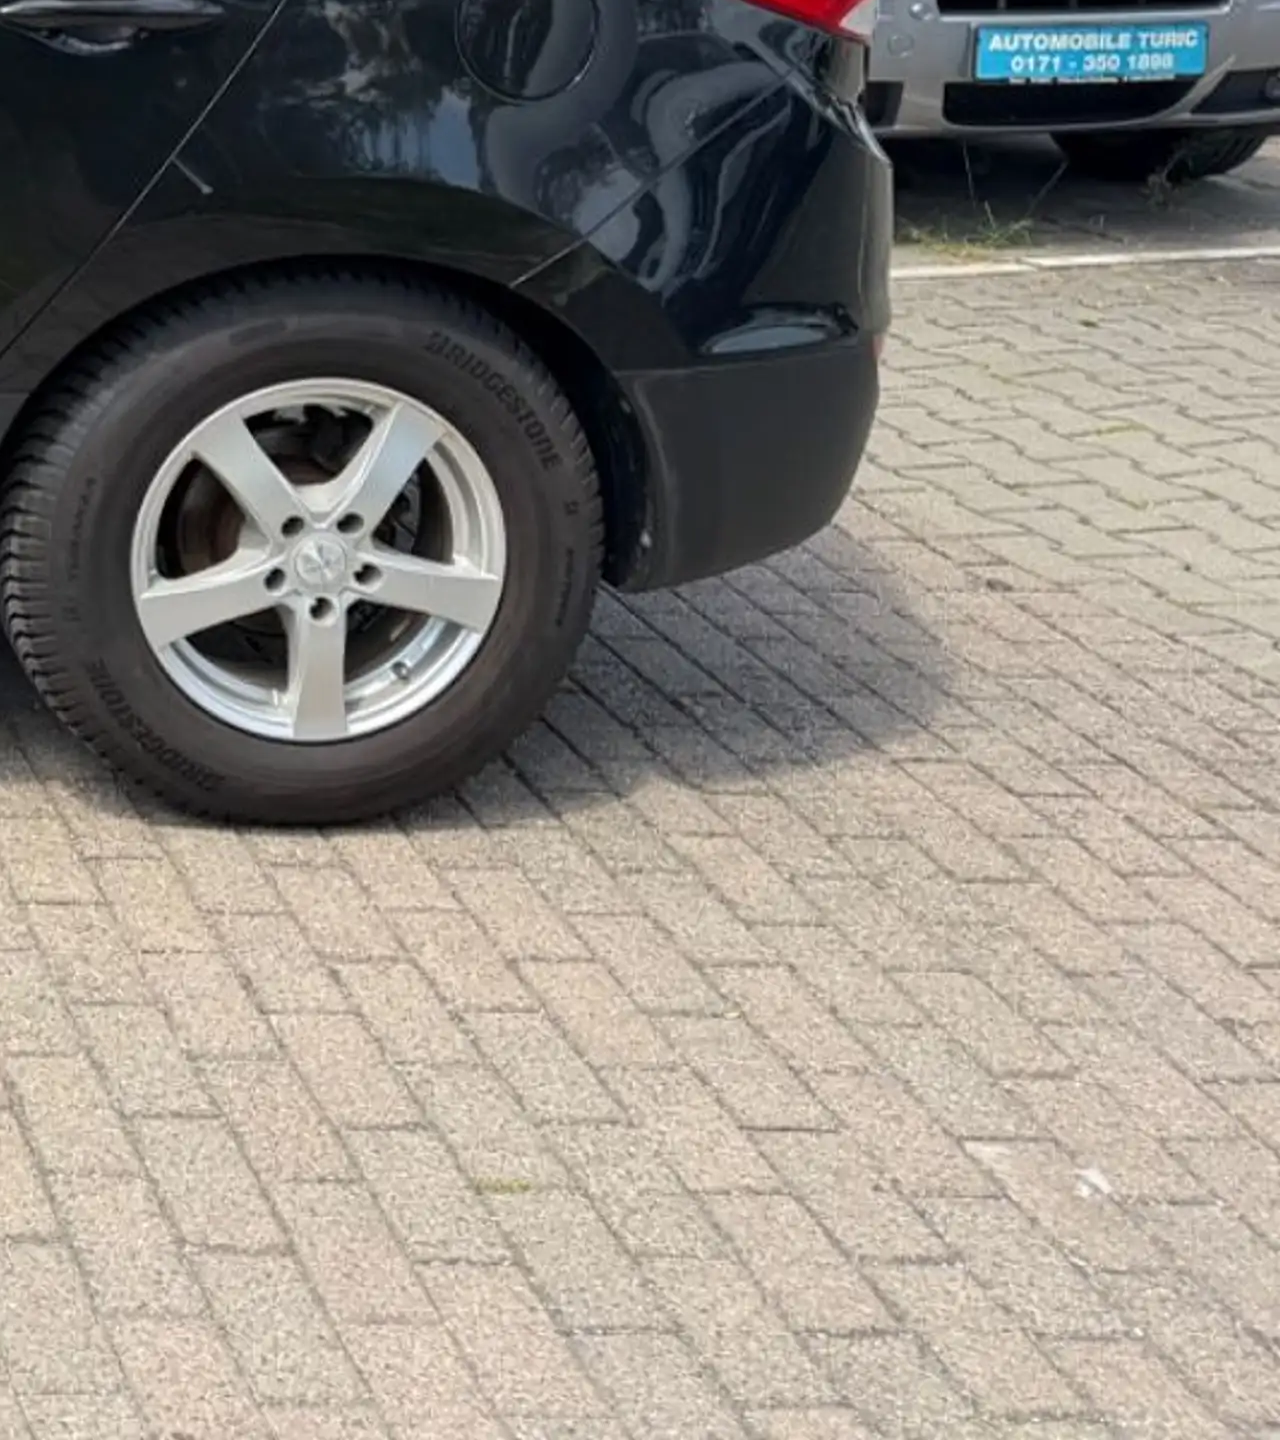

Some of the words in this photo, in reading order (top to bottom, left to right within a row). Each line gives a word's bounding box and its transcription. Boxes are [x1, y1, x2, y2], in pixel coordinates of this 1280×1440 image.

[989, 32, 1131, 52] AUTOMOBILE
[1138, 30, 1199, 48] TURIC
[1010, 54, 1061, 73] 0171
[1082, 55, 1121, 73] 350
